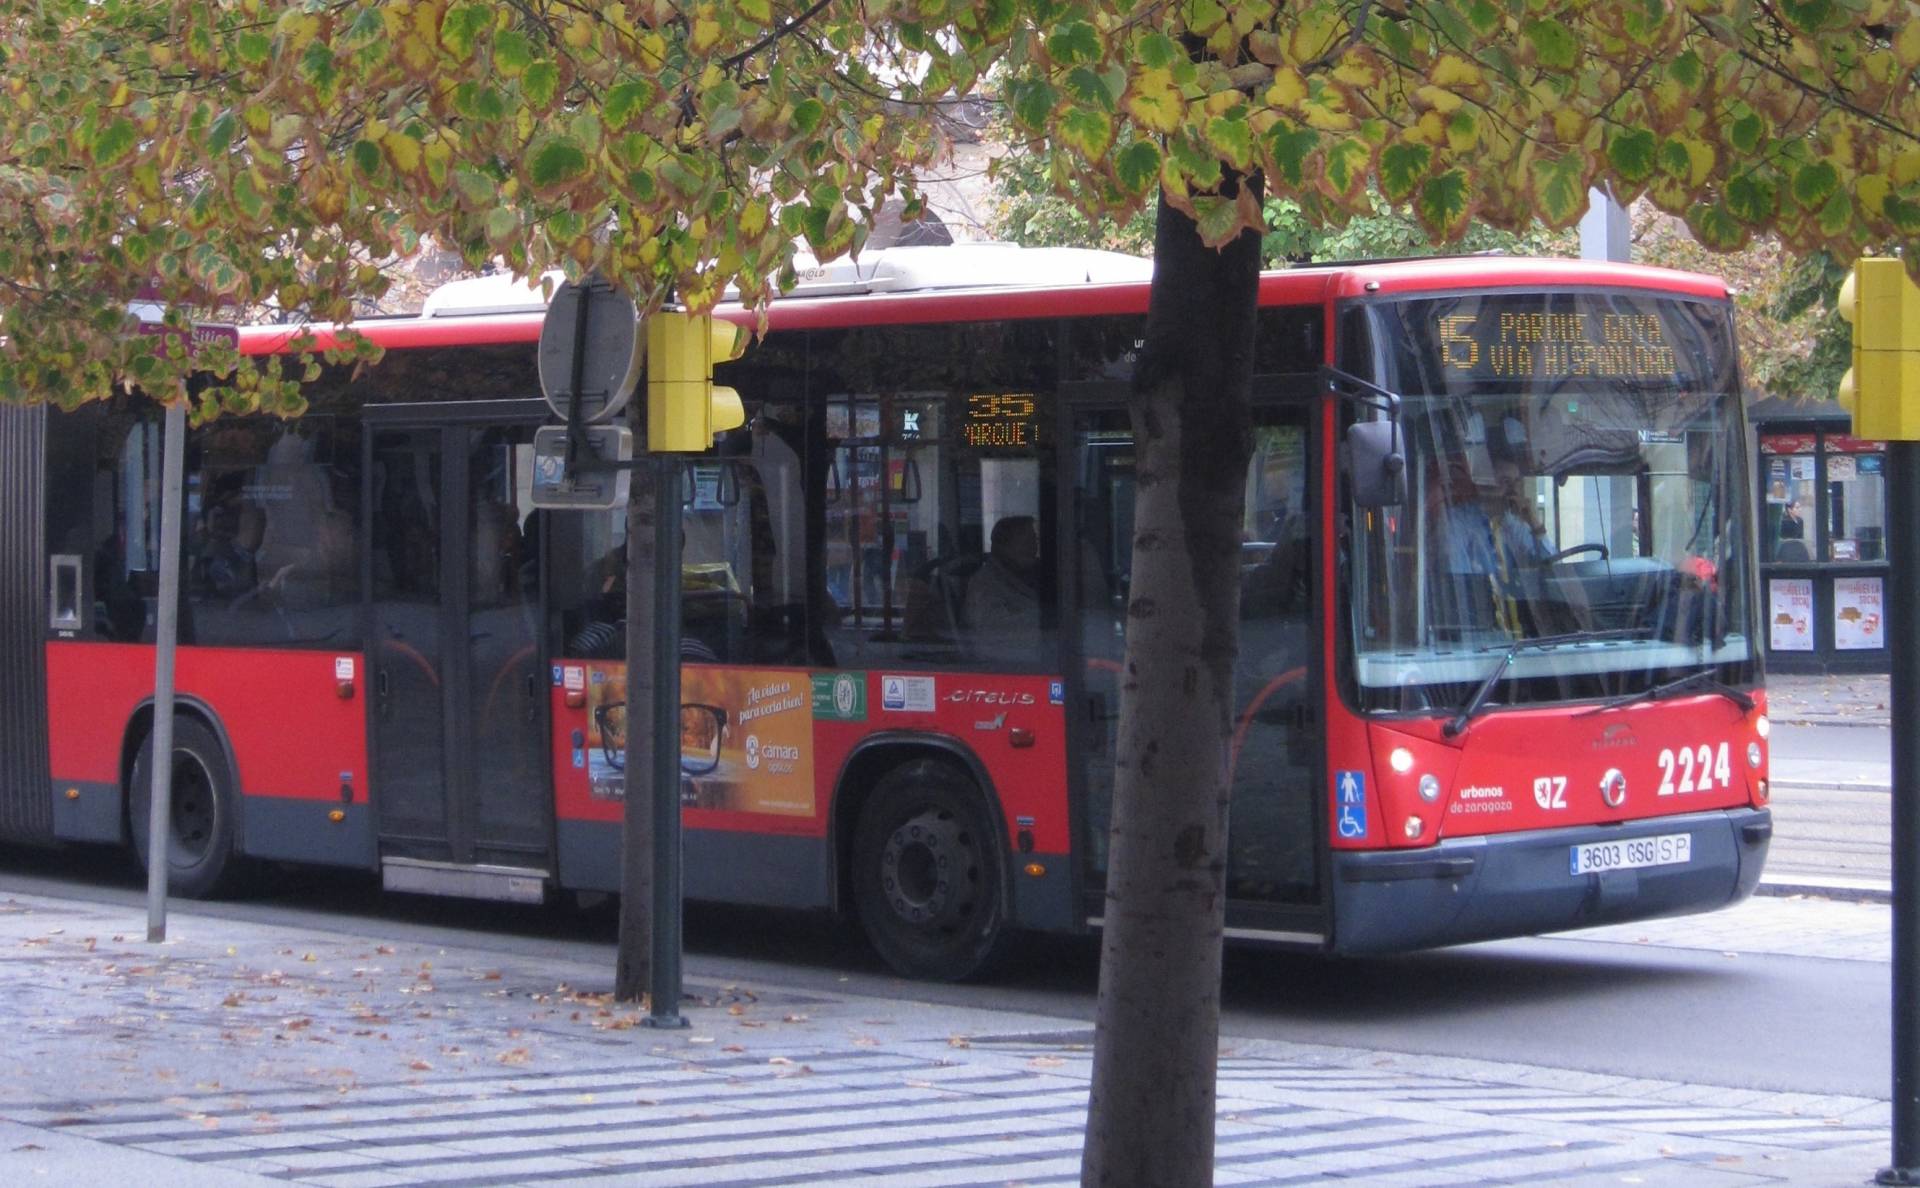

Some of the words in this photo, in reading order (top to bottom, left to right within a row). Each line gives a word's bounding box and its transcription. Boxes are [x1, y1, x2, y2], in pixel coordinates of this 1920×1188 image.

[1500, 312, 1588, 343] PARQUE
[1604, 313, 1662, 343] GOYA
[1490, 345, 1532, 376] VIA
[1545, 345, 1675, 376] HISPANIDAD
[968, 393, 1034, 417] 35
[761, 682, 780, 698] vida
[944, 689, 1035, 705] CITELIS
[738, 706, 760, 726] para
[762, 740, 798, 760] cámara
[1657, 741, 1731, 796] 2224
[1460, 785, 1503, 799] urbanos
[1450, 801, 1463, 813] de
[1465, 799, 1512, 813] zaragoza
[1583, 845, 1621, 869] 3603
[1628, 842, 1654, 864] GSG
